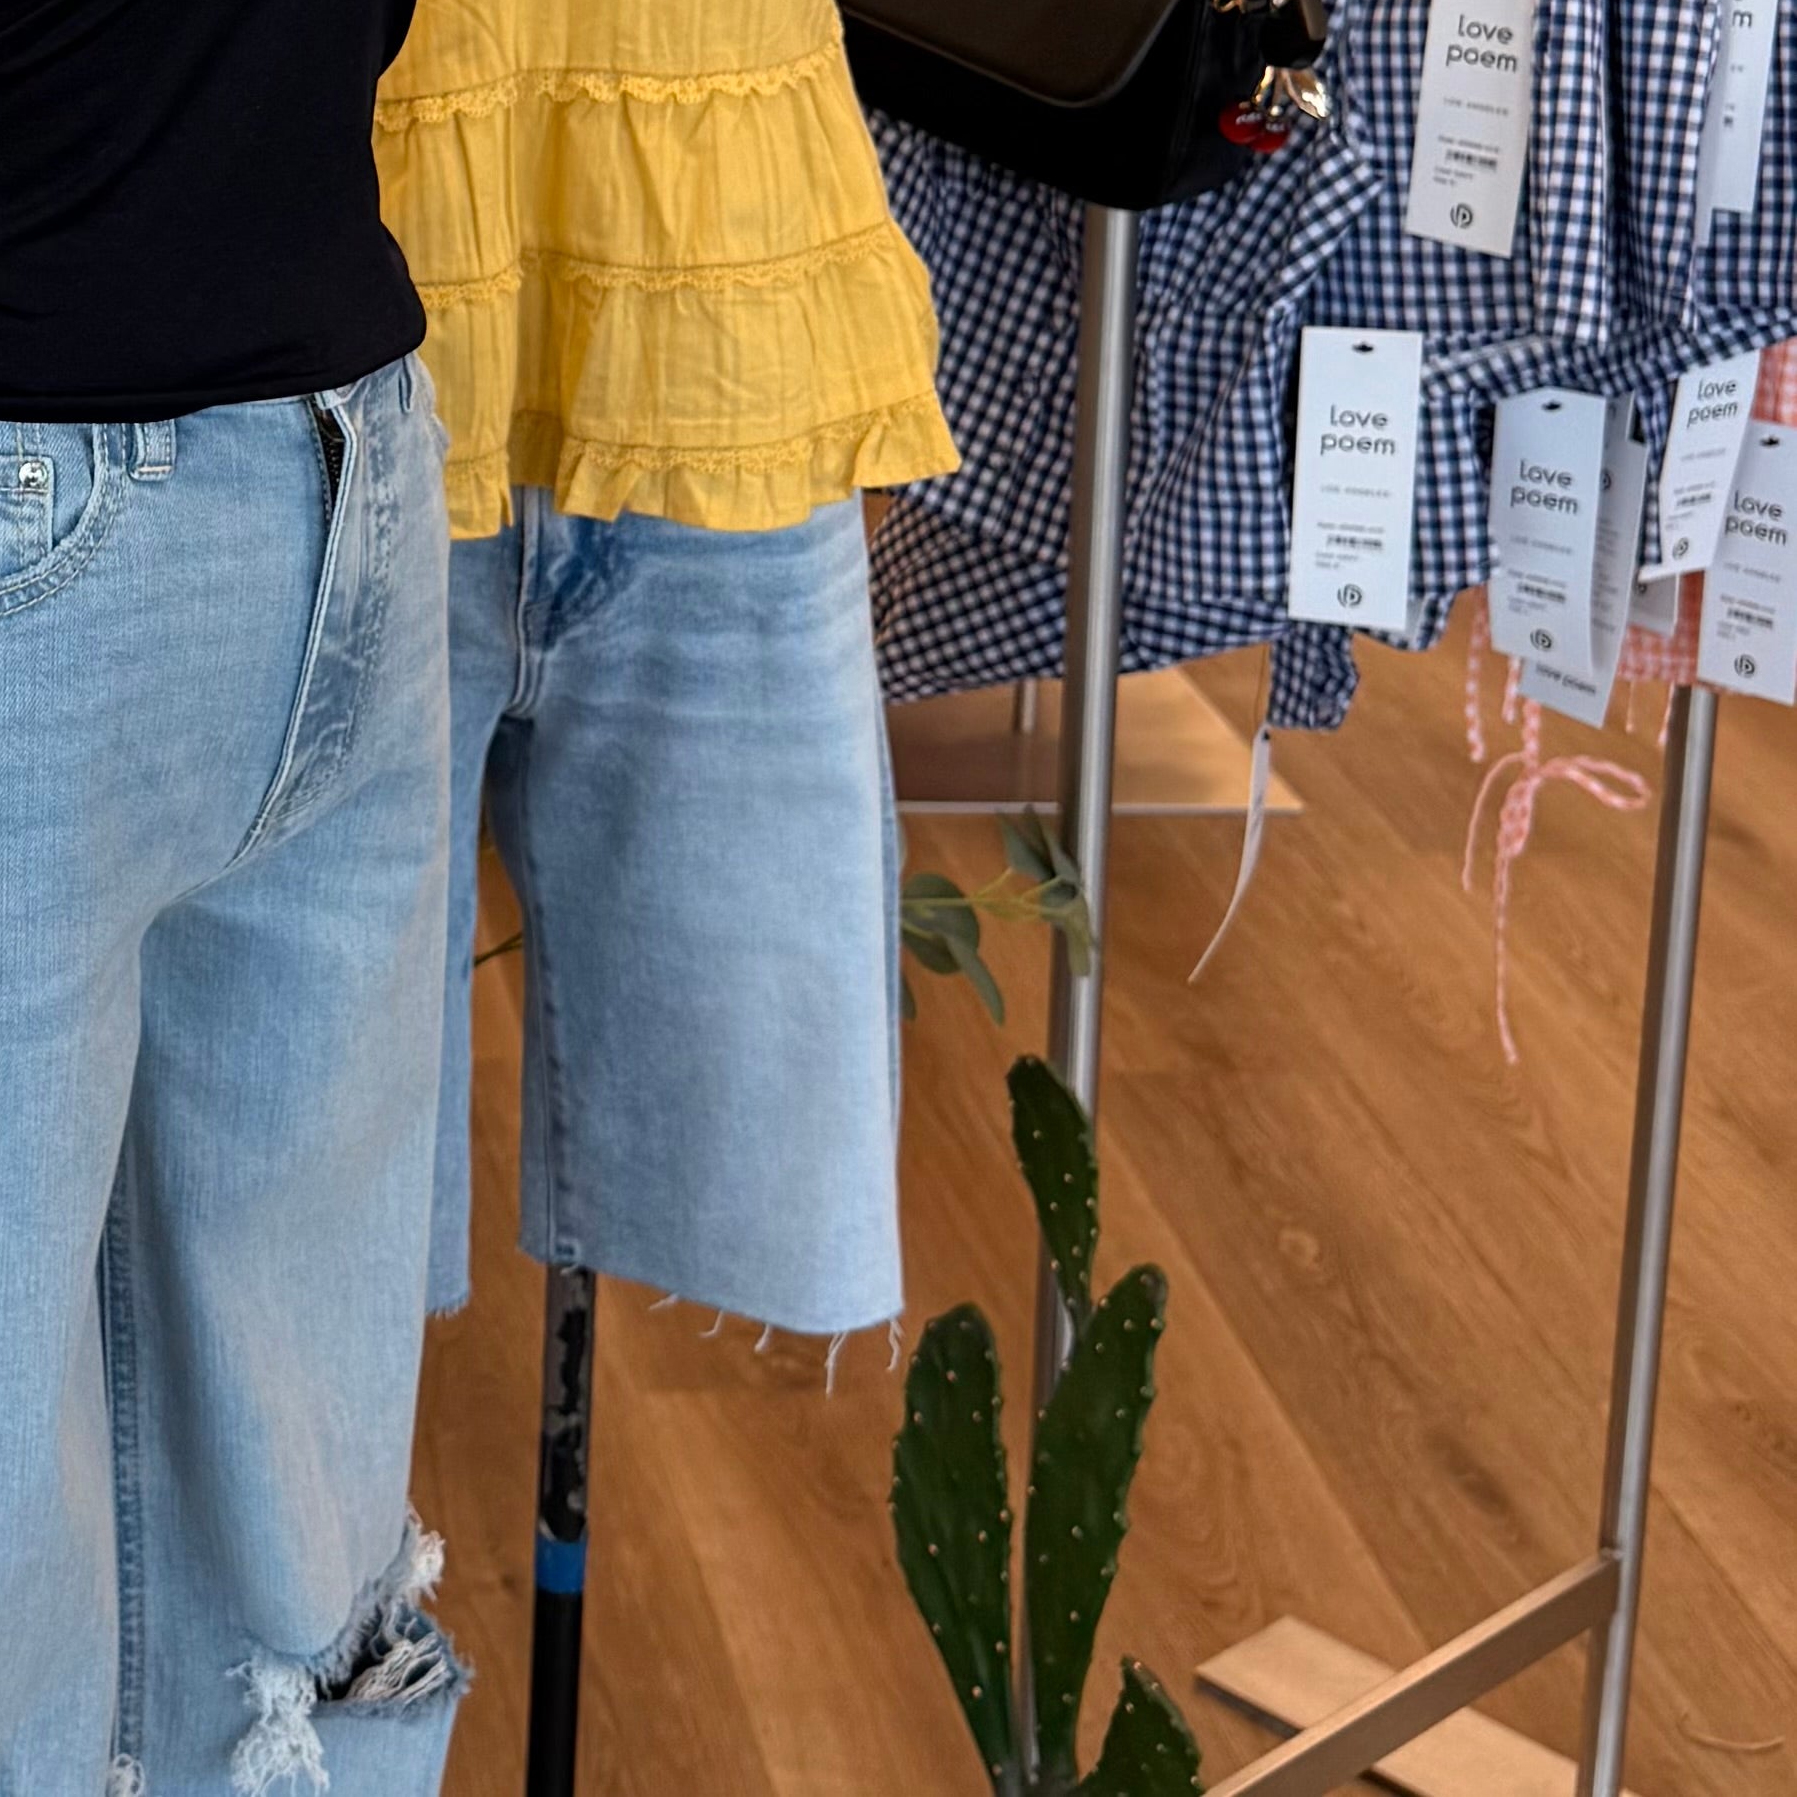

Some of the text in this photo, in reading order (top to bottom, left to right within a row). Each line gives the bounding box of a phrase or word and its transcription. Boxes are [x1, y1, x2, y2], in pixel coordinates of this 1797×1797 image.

[1457, 14, 1514, 45] love
[1445, 43, 1519, 73] poem
[1698, 379, 1738, 401] love
[1329, 404, 1389, 430] love
[1686, 402, 1739, 428] poem
[1319, 433, 1397, 456] poem
[1518, 458, 1574, 490] love
[1509, 485, 1579, 515] poem
[1733, 489, 1784, 521] love
[1724, 514, 1788, 547] poem
